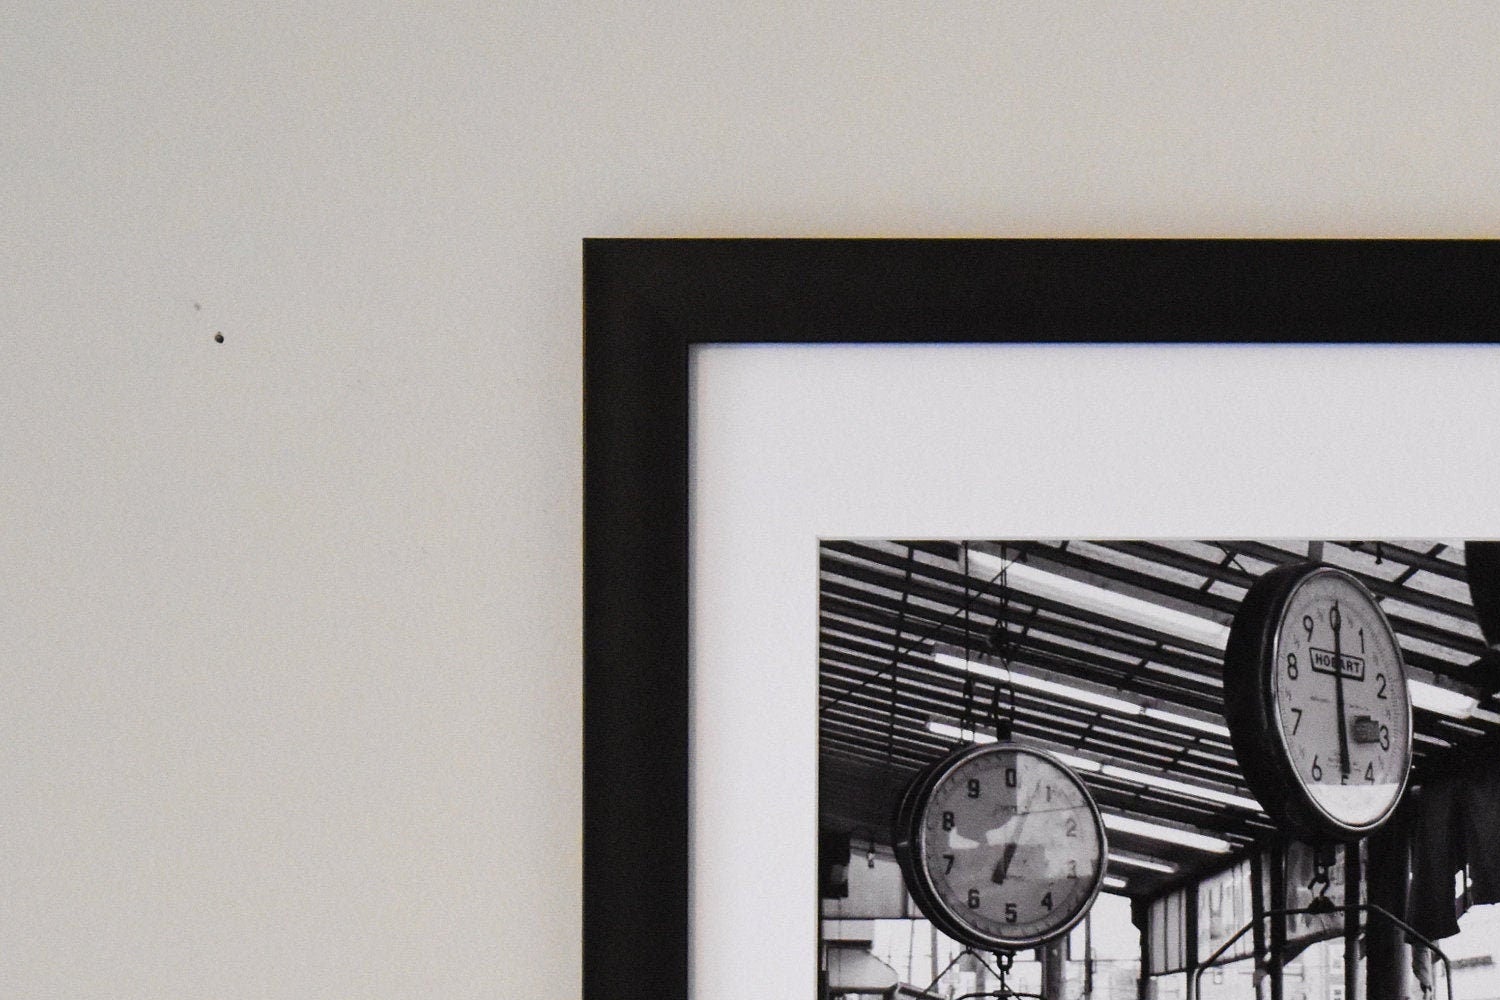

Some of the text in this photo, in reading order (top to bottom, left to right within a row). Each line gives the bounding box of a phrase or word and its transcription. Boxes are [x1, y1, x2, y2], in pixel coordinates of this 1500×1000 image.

[1303, 615, 1314, 642] 9
[1359, 627, 1365, 654] 1
[1287, 652, 1298, 680] 8
[1376, 673, 1387, 699] 2
[1291, 708, 1302, 735] 7
[1379, 725, 1390, 751] 3
[1005, 768, 1017, 788] 0
[1311, 755, 1322, 781] 6
[1364, 762, 1375, 785] 4
[967, 779, 980, 798] 9
[1046, 786, 1053, 802] 1
[942, 811, 955, 831] 8
[1066, 818, 1077, 837] 2
[943, 854, 955, 875] 7
[967, 889, 980, 909] 6
[1041, 892, 1053, 911] 4
[1005, 903, 1017, 923] 5
